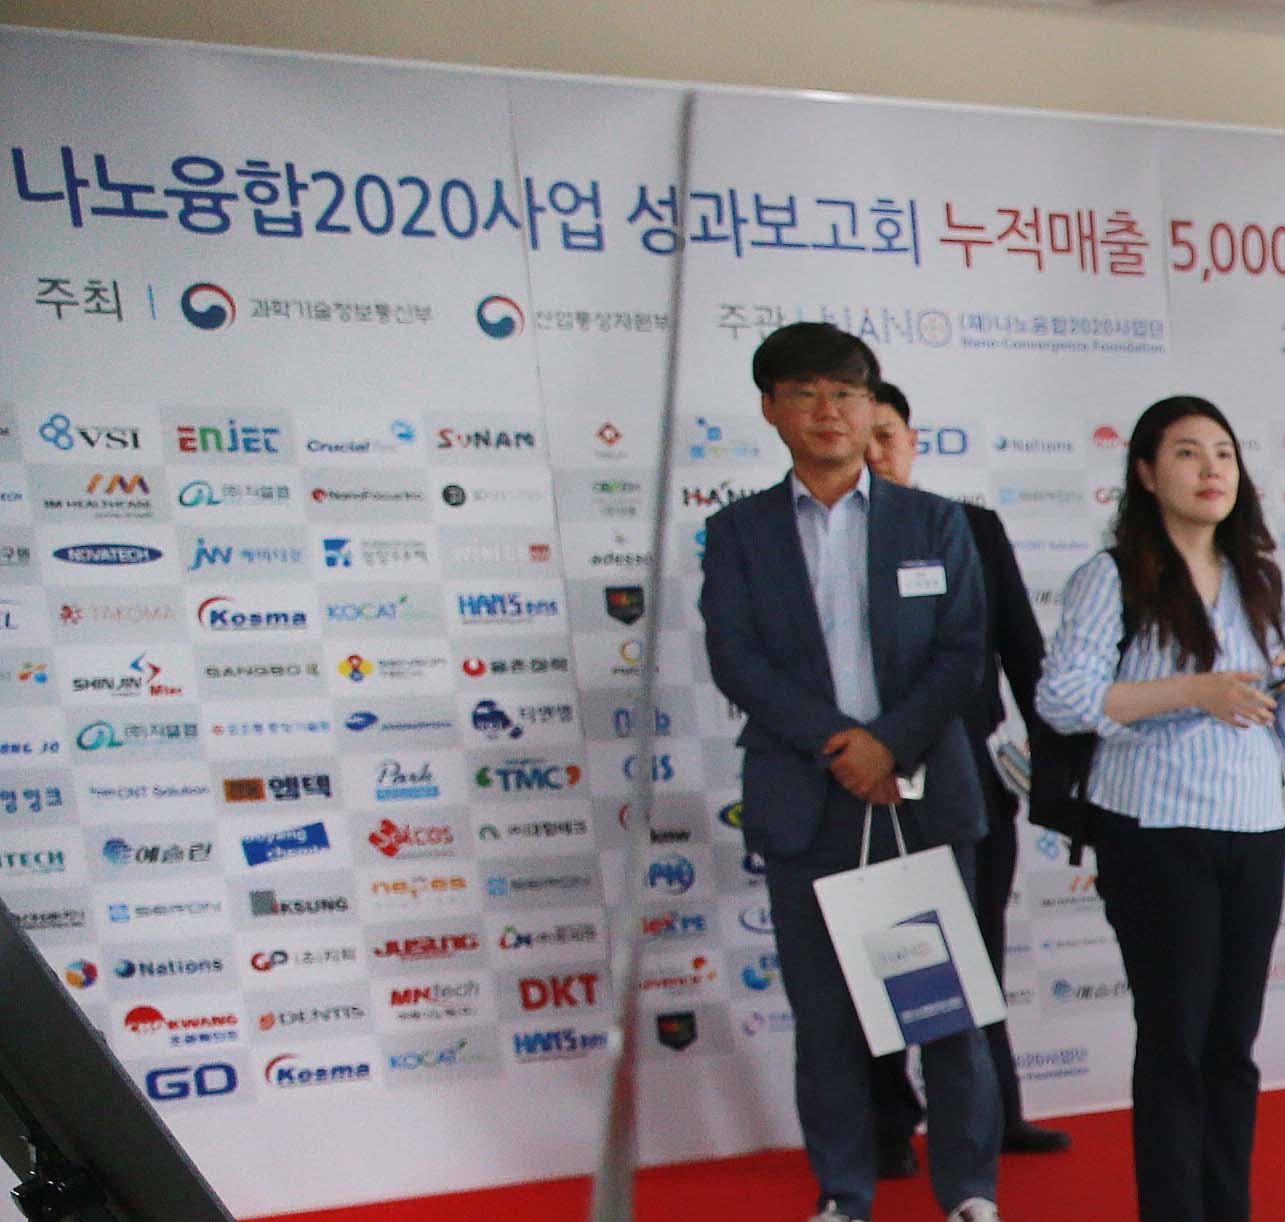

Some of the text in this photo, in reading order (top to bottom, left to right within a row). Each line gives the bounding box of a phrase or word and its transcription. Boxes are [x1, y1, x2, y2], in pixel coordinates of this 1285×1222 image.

[10, 146, 605, 253] 나노융합2020사업
[626, 182, 923, 268] 성과보고회
[937, 200, 1150, 277] 누적매출
[34, 277, 124, 324] 주최
[715, 304, 785, 342] 주관
[76, 427, 141, 450] VSI
[209, 608, 307, 628] Kosma
[497, 764, 566, 792] TMC
[138, 957, 224, 978] Nations
[517, 972, 599, 1011] DKT
[276, 1061, 371, 1085] Kosma
